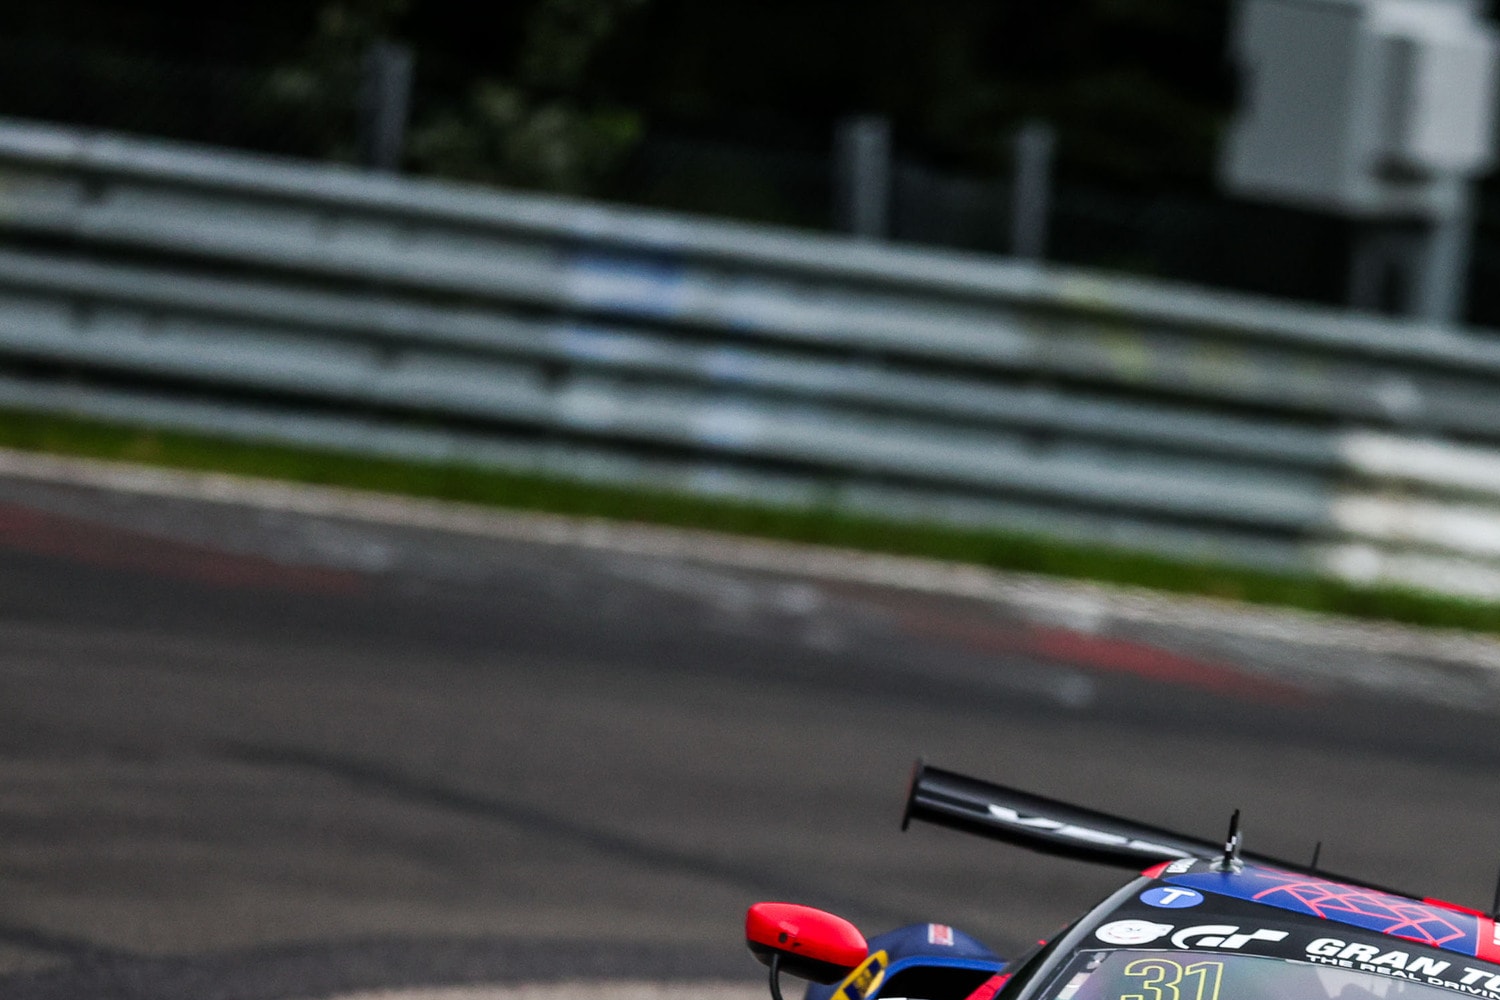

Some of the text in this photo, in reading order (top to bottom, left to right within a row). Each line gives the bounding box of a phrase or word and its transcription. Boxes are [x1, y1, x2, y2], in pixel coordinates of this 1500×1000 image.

[1304, 937, 1452, 977] GRAN
[1304, 954, 1353, 968] THE
[1359, 962, 1422, 983] REAL
